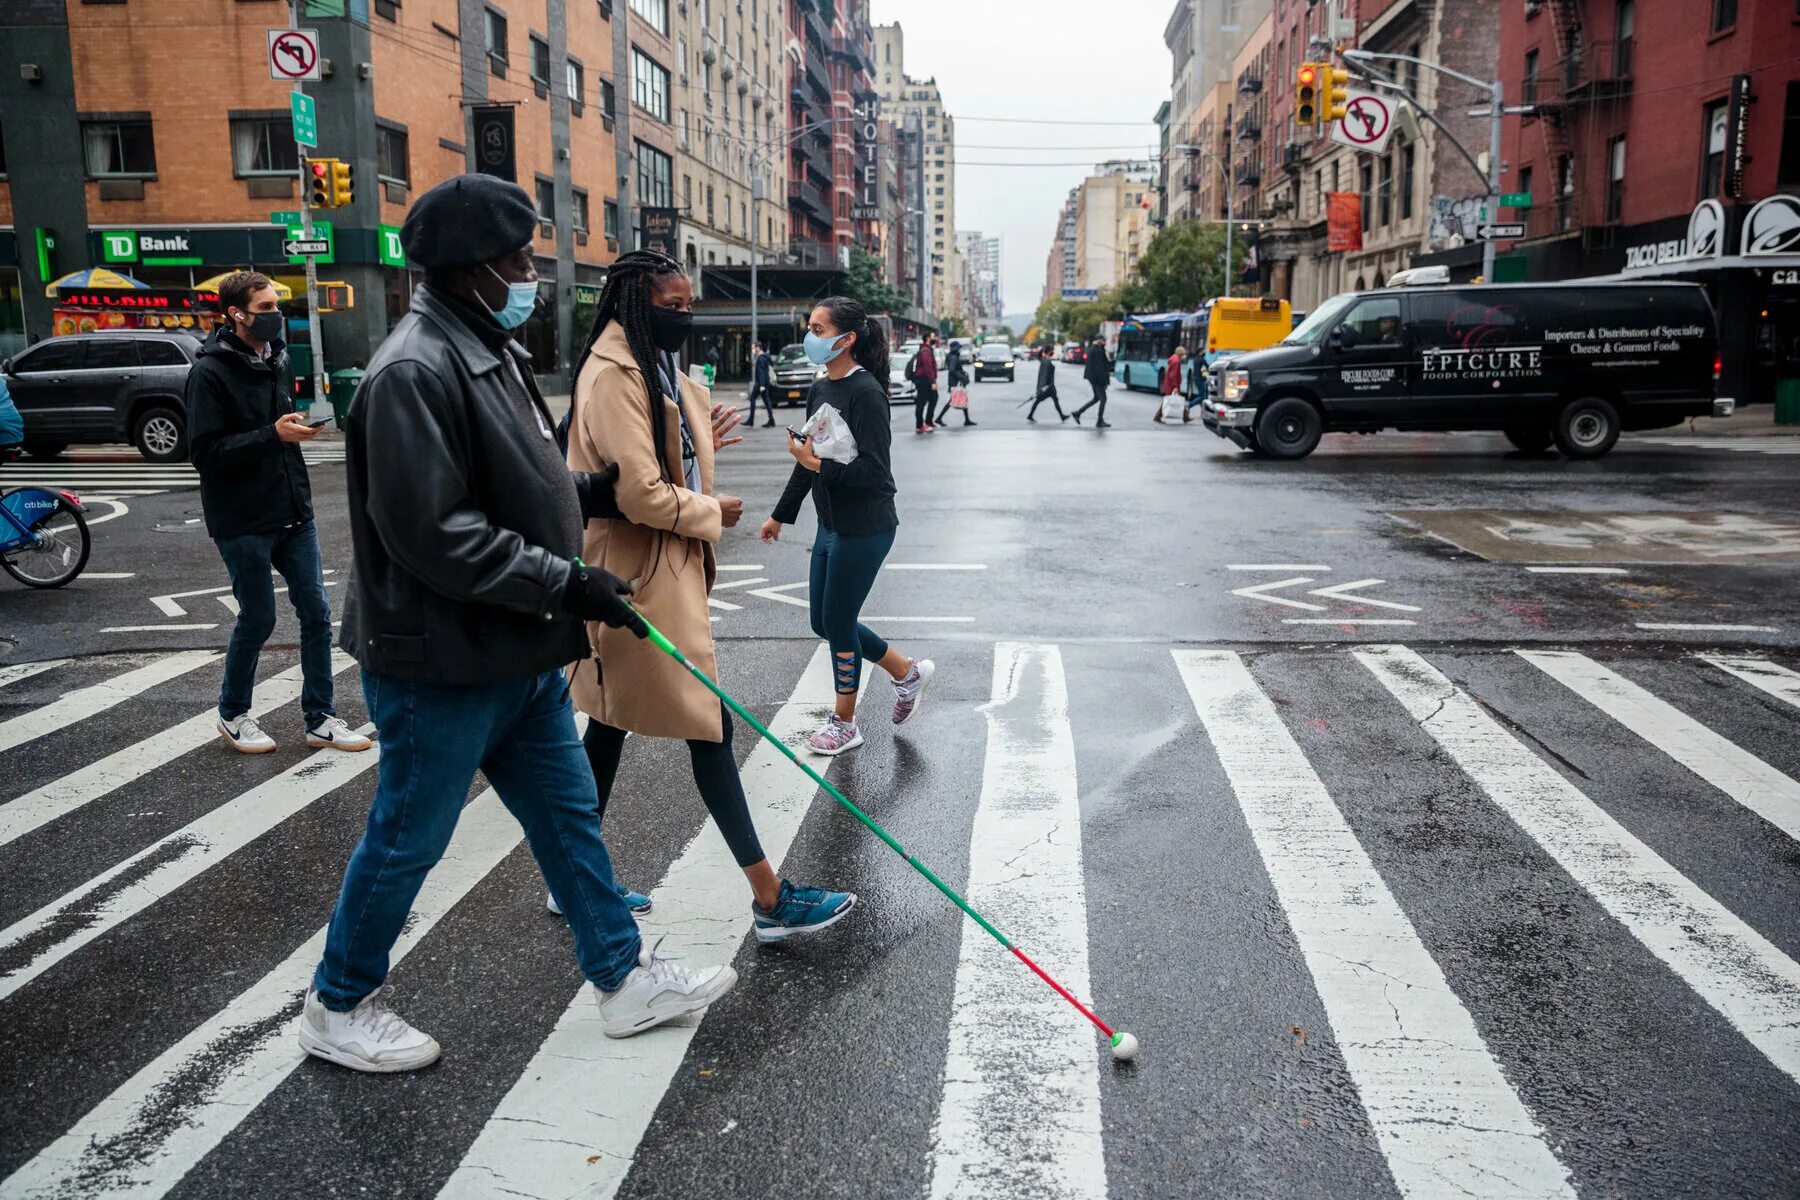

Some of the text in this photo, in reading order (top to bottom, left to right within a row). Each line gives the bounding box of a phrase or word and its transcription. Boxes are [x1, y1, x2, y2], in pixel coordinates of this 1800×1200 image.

[863, 100, 877, 205] HOTEL
[106, 236, 189, 256] TD Bank
[1626, 238, 1689, 268] TACO BELL
[1544, 329, 1586, 343] Importers
[1587, 327, 1596, 339] &
[1598, 325, 1649, 339] Distributors
[1650, 325, 1661, 337] of
[1570, 340, 1681, 354] Cheese & Gourmet Foods
[1422, 352, 1542, 372] EPICURE
[1422, 369, 1542, 380] FOODS CORPORATION
